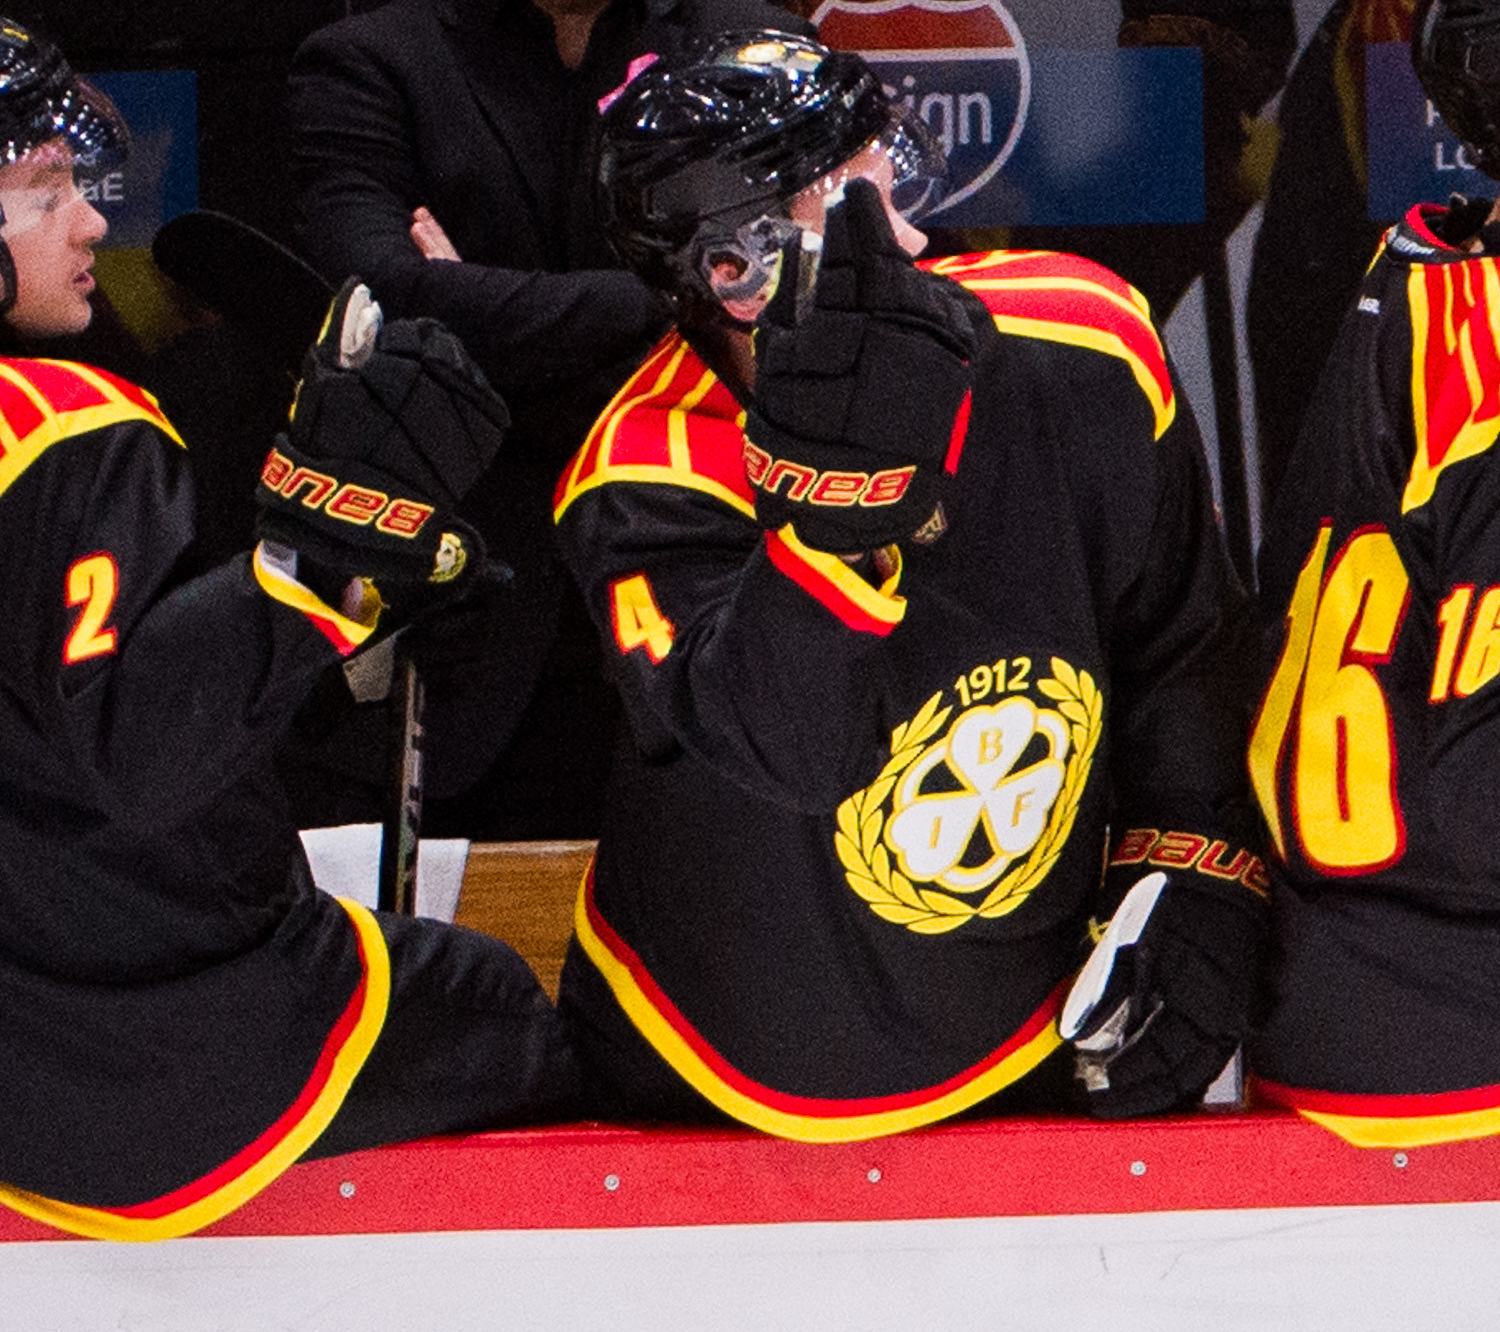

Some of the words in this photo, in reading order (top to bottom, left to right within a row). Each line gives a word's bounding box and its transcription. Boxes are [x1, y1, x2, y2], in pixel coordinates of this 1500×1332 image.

[262, 452, 436, 539] BAUE
[740, 436, 918, 507] BAUE
[607, 571, 676, 666] 4
[953, 656, 1033, 706] 1912
[977, 727, 1005, 763] B
[1009, 791, 1041, 827] F
[1110, 827, 1272, 900] BAUE
